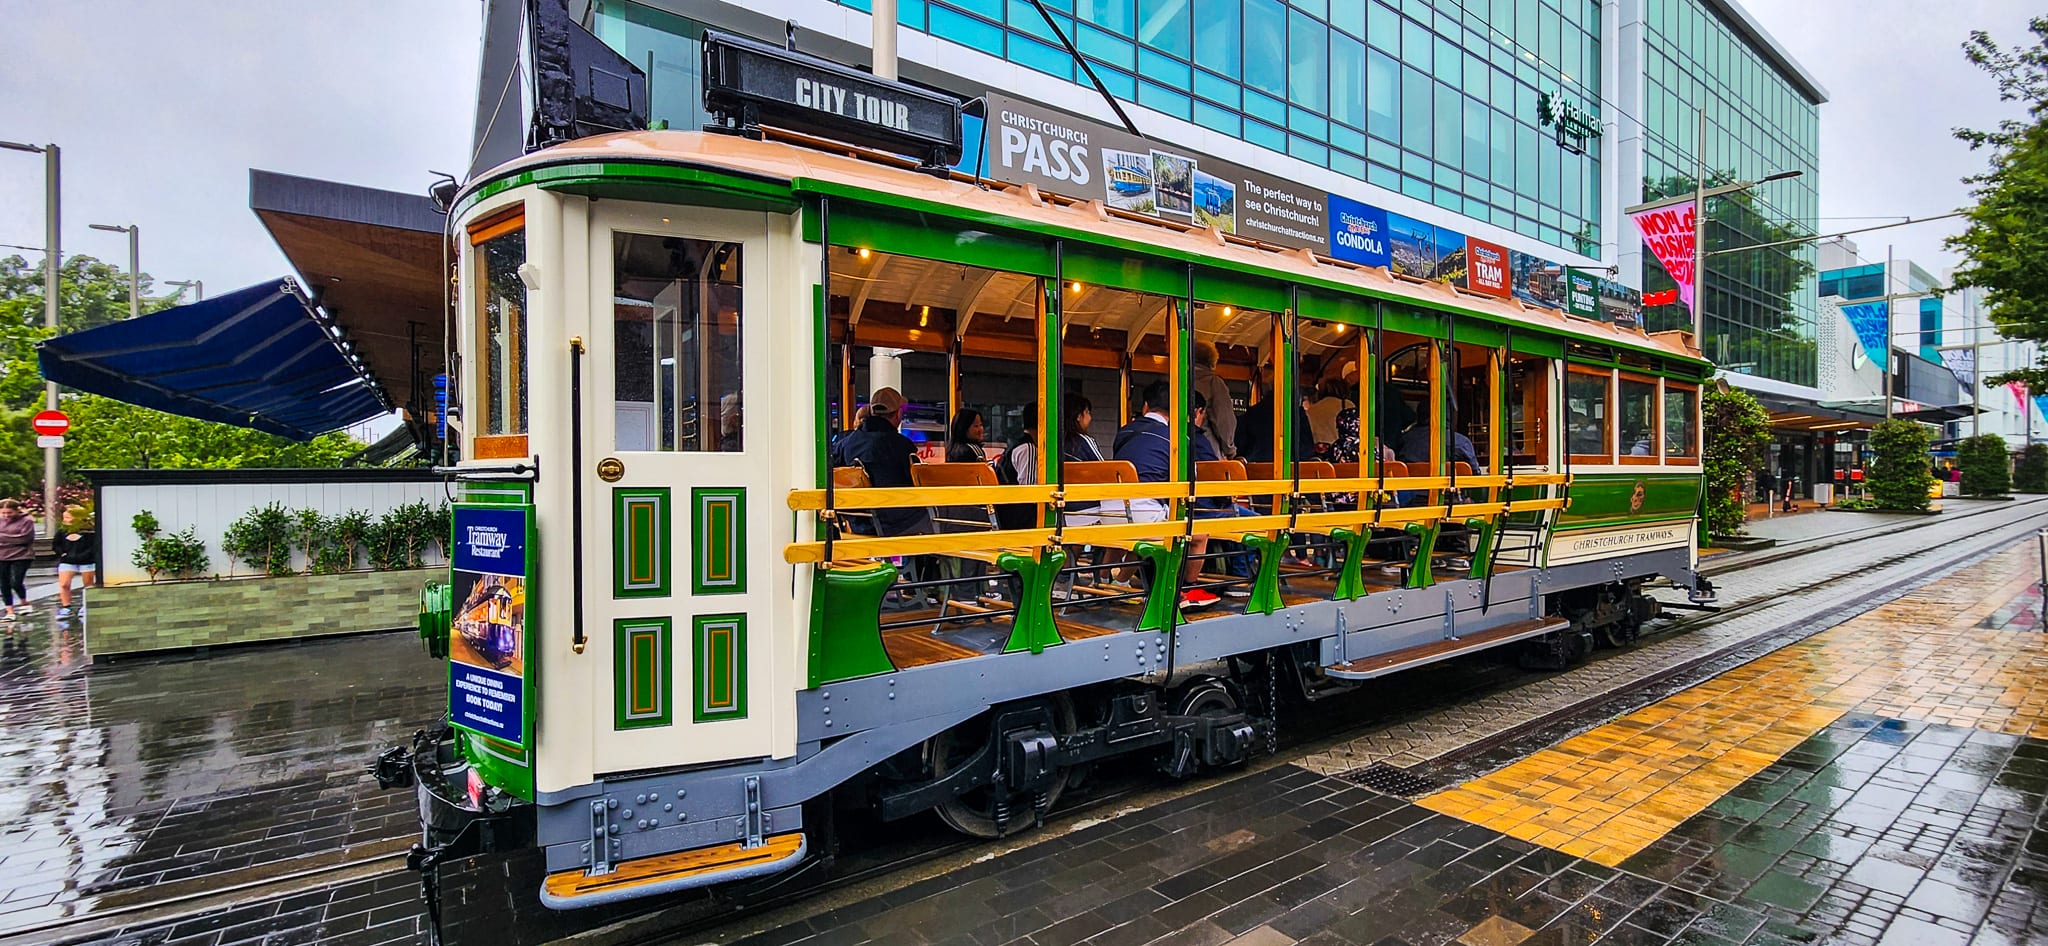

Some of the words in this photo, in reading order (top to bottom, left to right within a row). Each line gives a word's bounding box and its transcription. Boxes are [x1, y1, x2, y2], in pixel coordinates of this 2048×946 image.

[796, 78, 846, 115] CITY
[854, 92, 909, 131] TOUR
[1001, 110, 1088, 145] CHRISTCHURCH
[1567, 101, 1604, 136] Harmans
[1001, 125, 1090, 185] PASS
[1244, 180, 1261, 195] The
[1263, 187, 1295, 205] perfect
[1296, 197, 1312, 211] way
[1314, 200, 1322, 212] to
[1245, 199, 1262, 211] see
[1263, 202, 1319, 227] Christchurch!
[1340, 212, 1378, 232] Christchurch
[1245, 217, 1325, 244] christchurchattractions.nz
[1336, 231, 1384, 255] GONDOLA
[1475, 261, 1502, 283] TRAM
[1572, 291, 1595, 307] PUNTING
[466, 526, 509, 552] Tramway
[1573, 534, 1634, 551] CHRISTCHURCH
[1636, 530, 1674, 543] TRAMWAYS.
[471, 545, 501, 559] Restaurant
[466, 694, 482, 707] BOOK
[482, 699, 503, 713] TODAY!
[482, 686, 488, 696] TO
